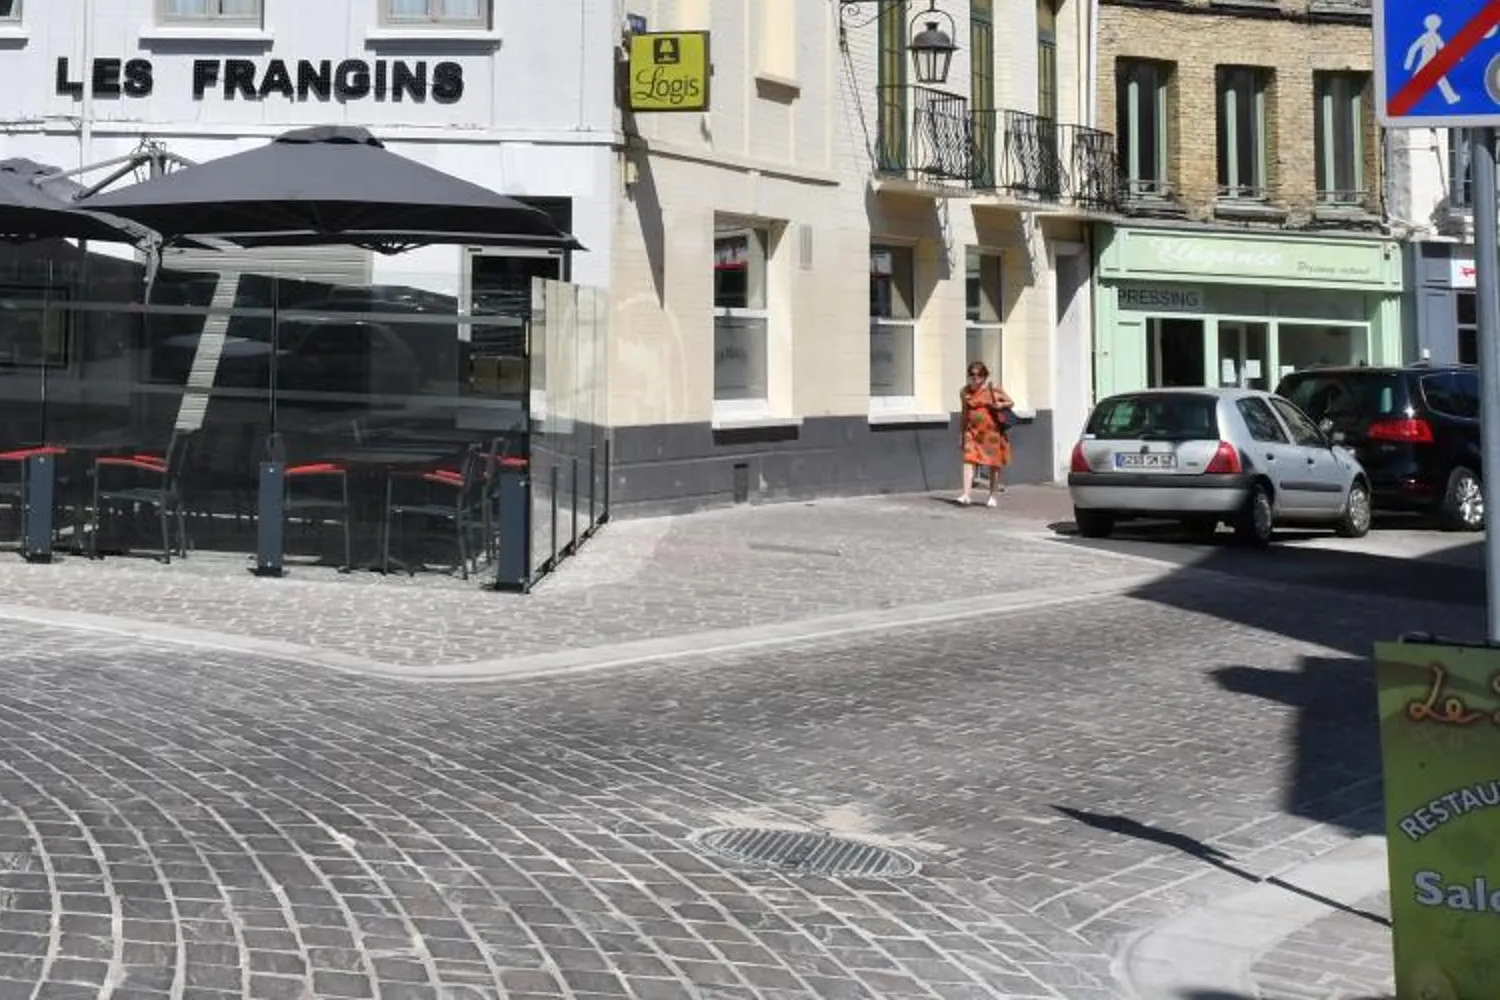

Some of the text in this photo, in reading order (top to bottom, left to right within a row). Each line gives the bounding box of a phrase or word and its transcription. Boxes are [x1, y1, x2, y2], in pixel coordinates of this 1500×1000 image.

[56, 56, 465, 104] LES FRANGINS
[633, 66, 700, 104] Logis
[1118, 287, 1199, 308] PRESSING
[1400, 781, 1500, 841] RESTAU
